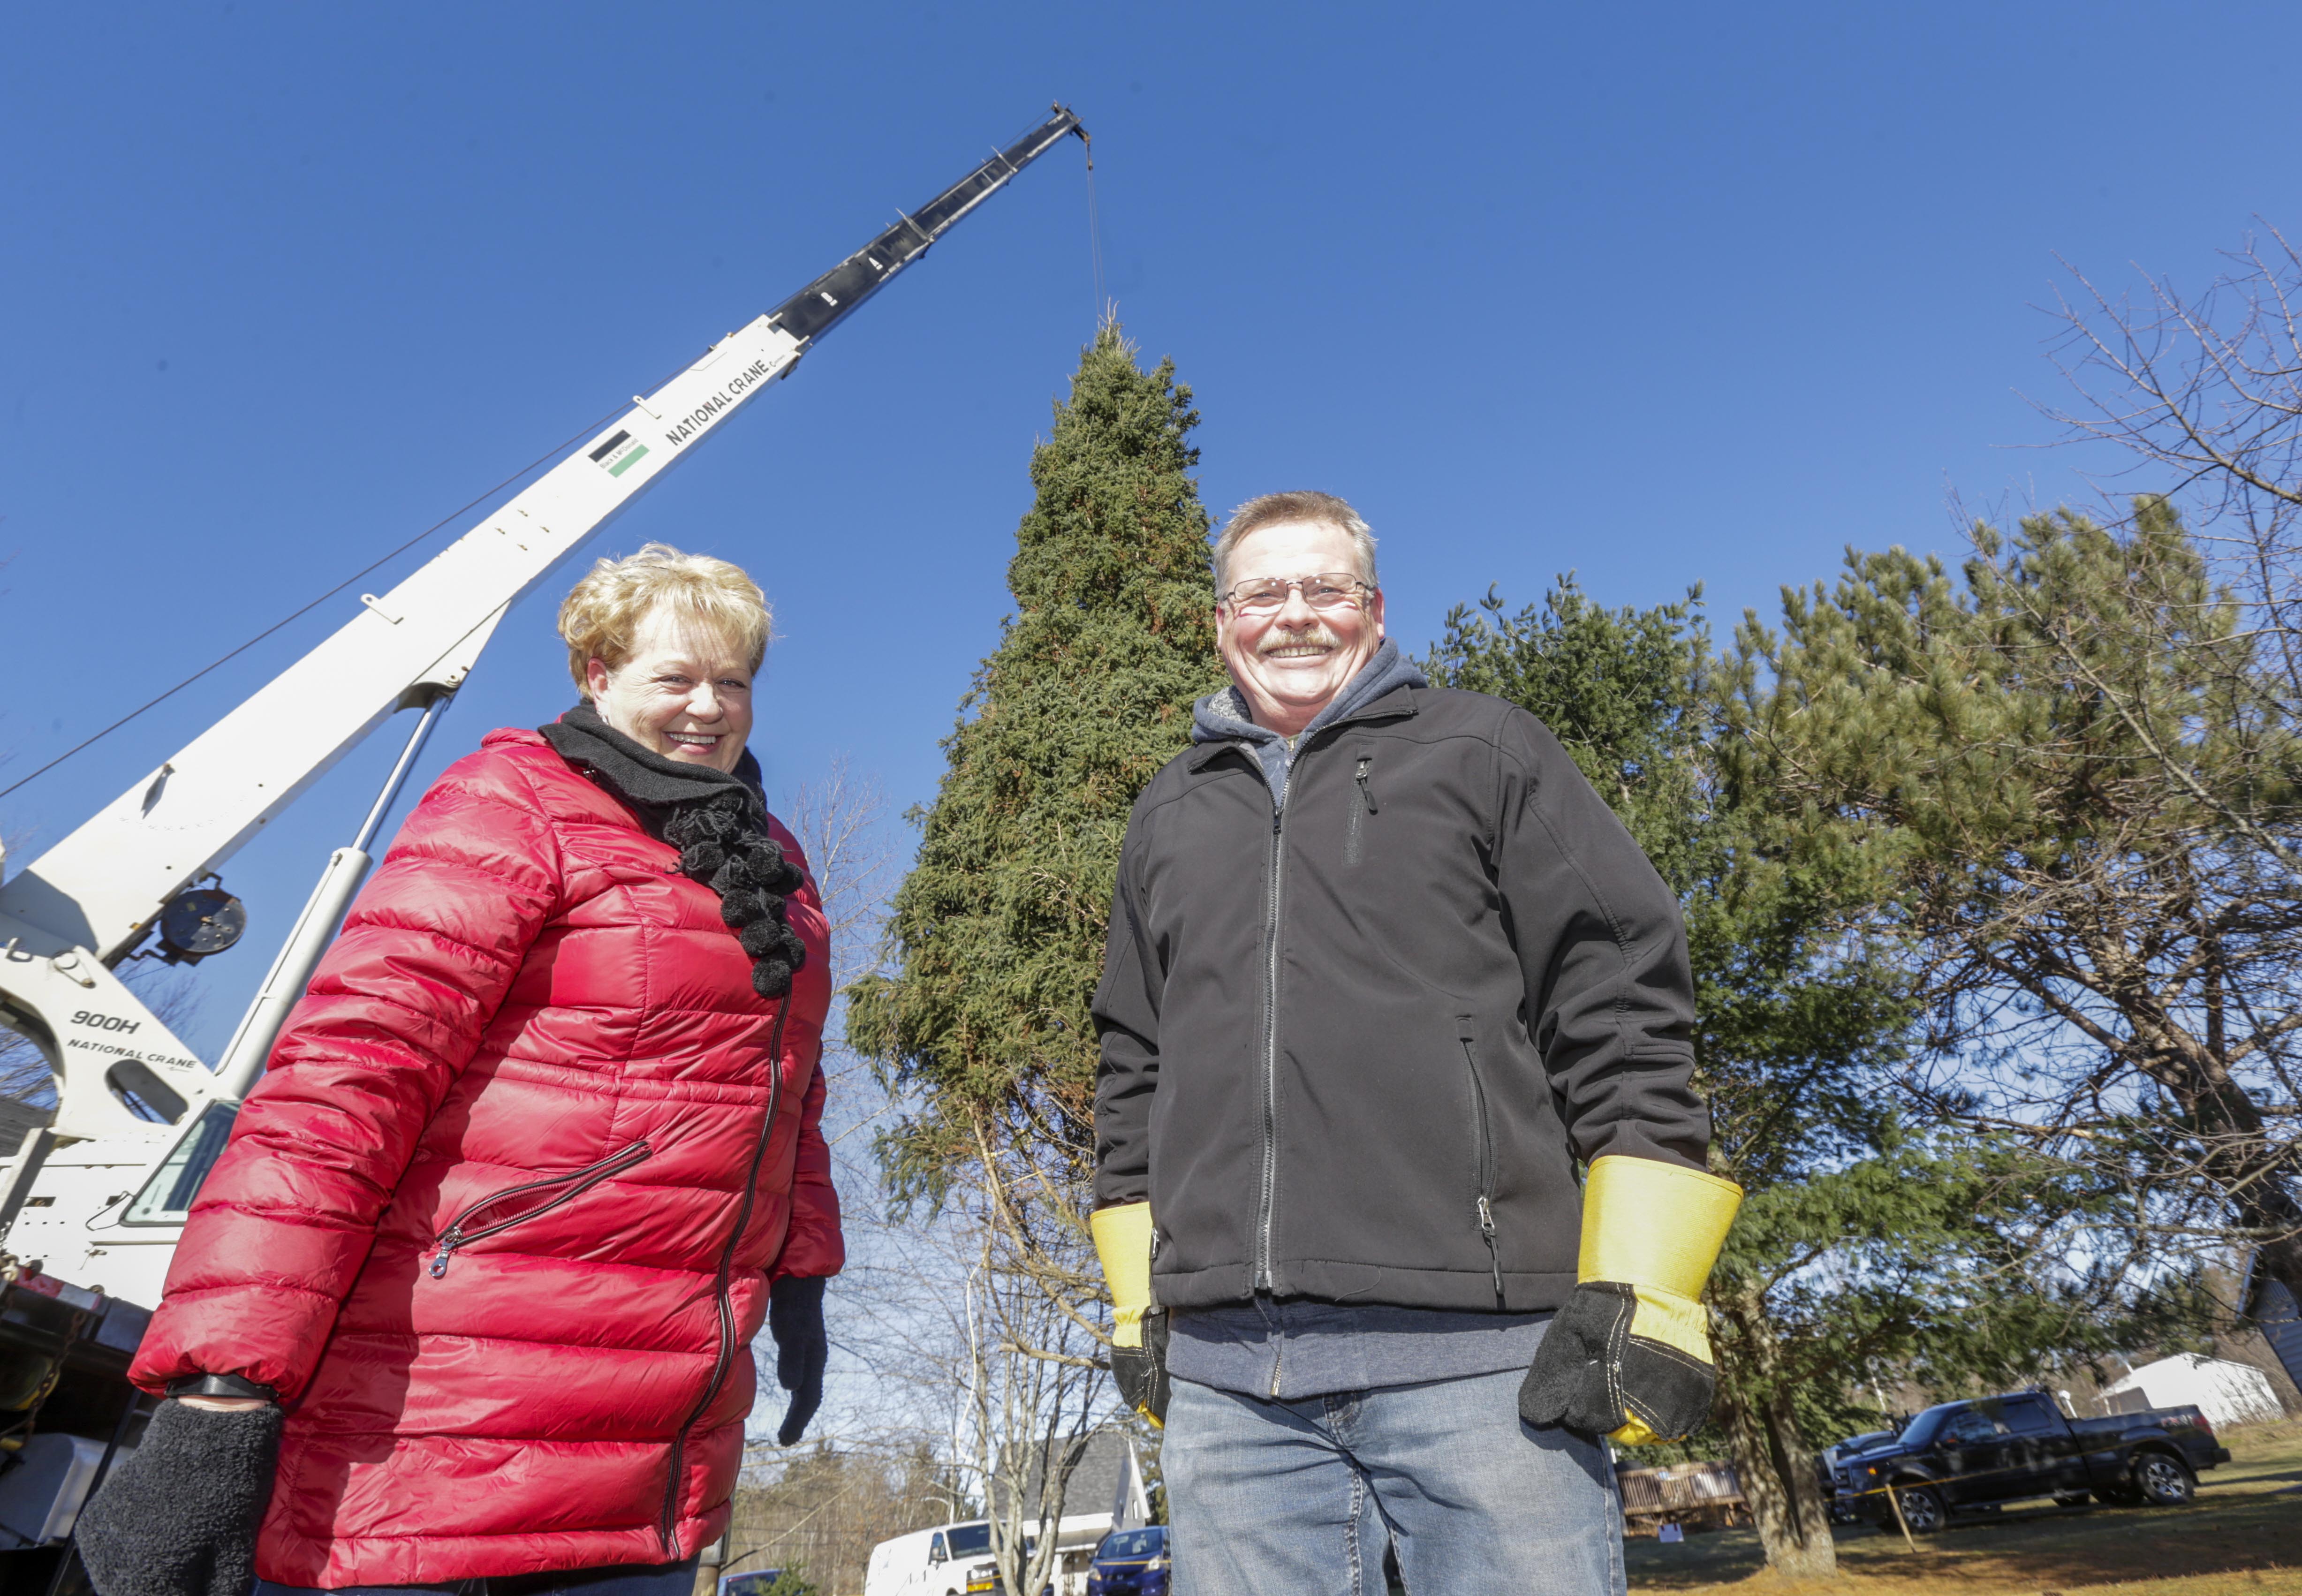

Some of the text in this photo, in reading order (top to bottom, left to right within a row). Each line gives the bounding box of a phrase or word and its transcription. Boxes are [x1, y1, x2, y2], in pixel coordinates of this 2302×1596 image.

[666, 360, 769, 446] NATIONAL CRANE
[70, 1010, 141, 1035] 900H
[67, 1038, 197, 1068] NATIONAL CRANE
